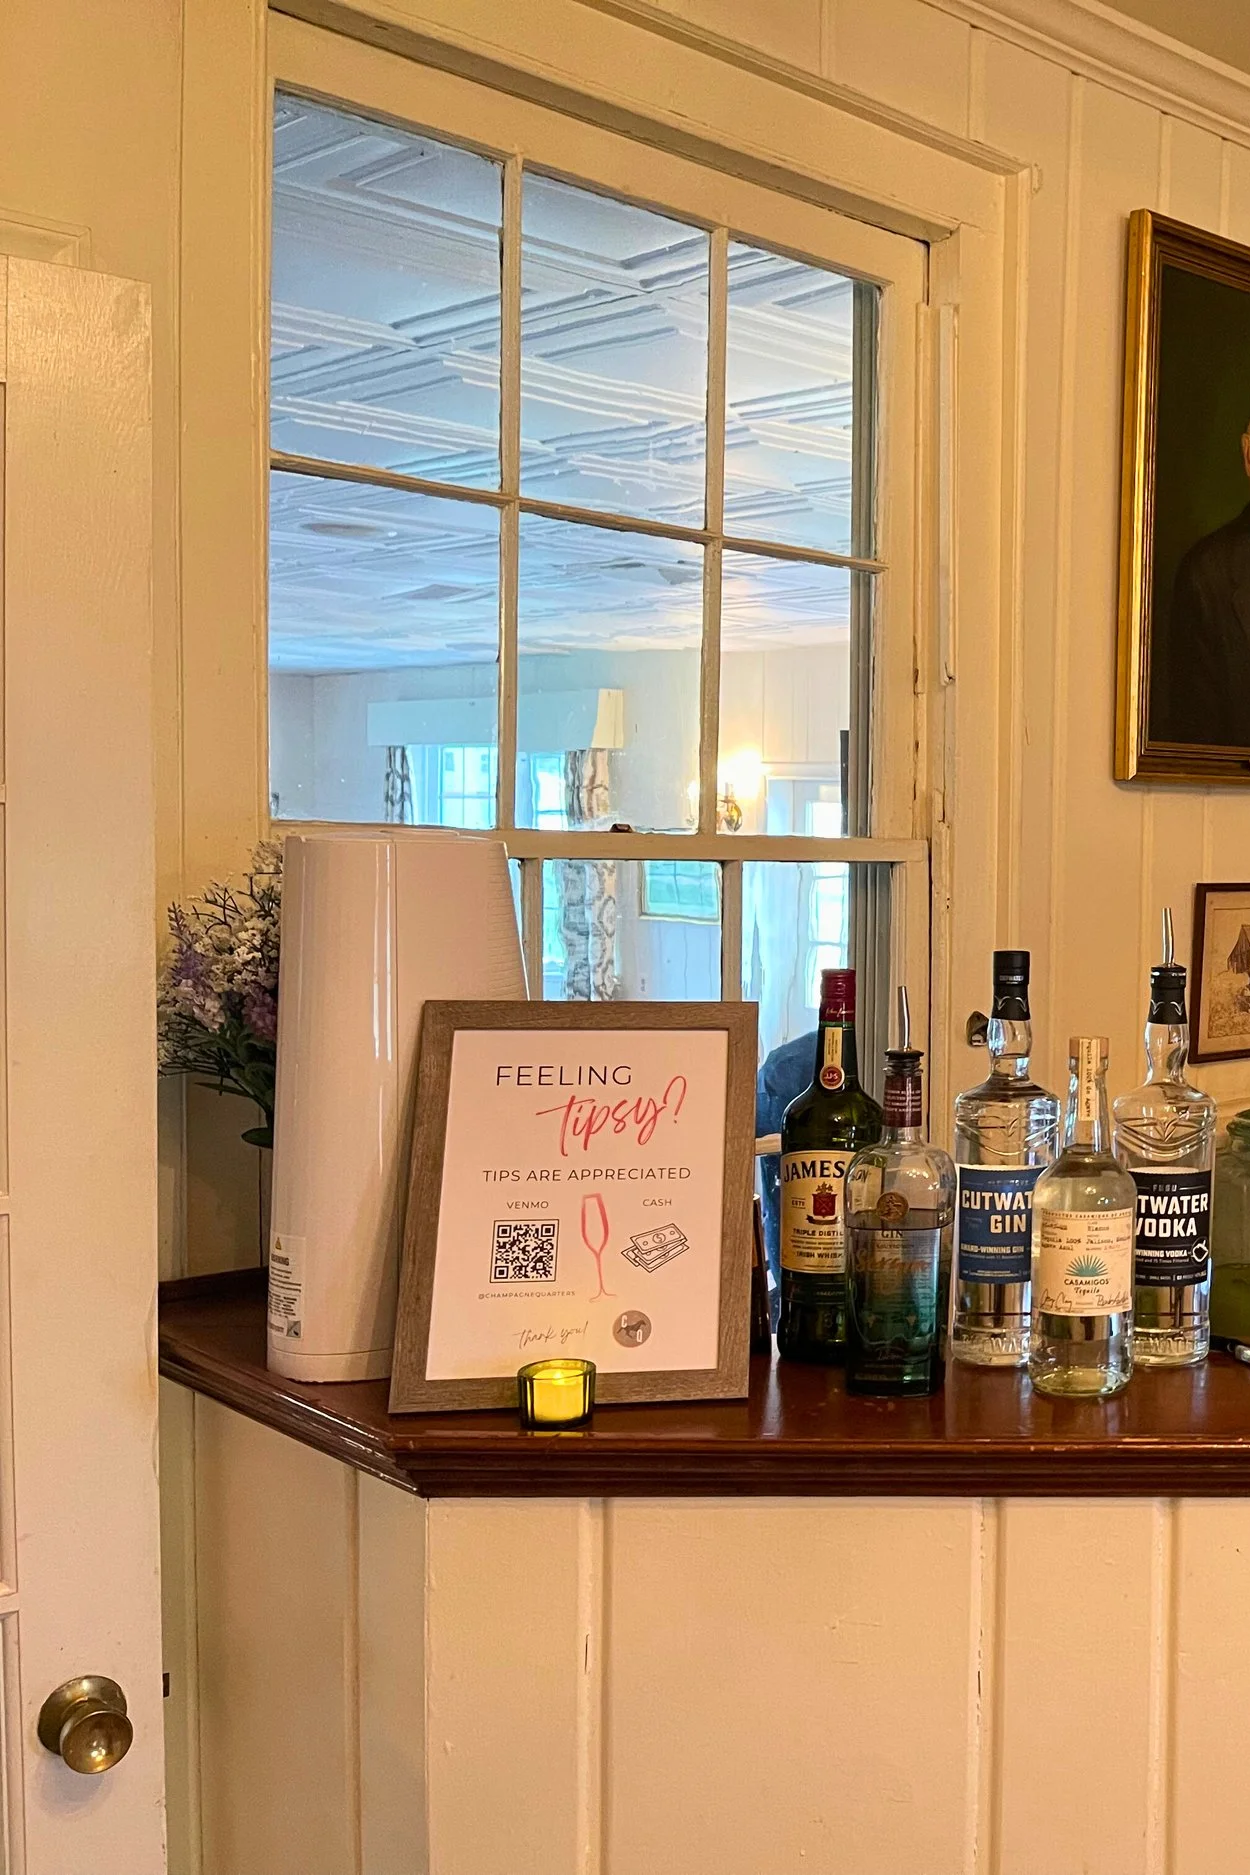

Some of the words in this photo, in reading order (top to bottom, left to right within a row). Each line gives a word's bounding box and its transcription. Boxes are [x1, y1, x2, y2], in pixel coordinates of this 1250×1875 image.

[496, 1065, 632, 1086] FEELING
[536, 1075, 687, 1156] tipsy?
[482, 1169, 521, 1182] TIPS
[526, 1169, 562, 1182] ARE
[567, 1167, 691, 1181] APPRECIATED
[783, 1160, 846, 1183] JAMES
[506, 1201, 549, 1210] VENMO
[642, 1198, 672, 1207] CASH
[962, 1189, 1034, 1211] CUTWAT
[1138, 1192, 1209, 1215] TWATER
[990, 1214, 1027, 1234] GIN
[1063, 1278, 1110, 1286] CASAMIGOS
[1074, 1286, 1100, 1296] Tequila
[512, 1327, 557, 1350] thank
[560, 1320, 589, 1345] you!
